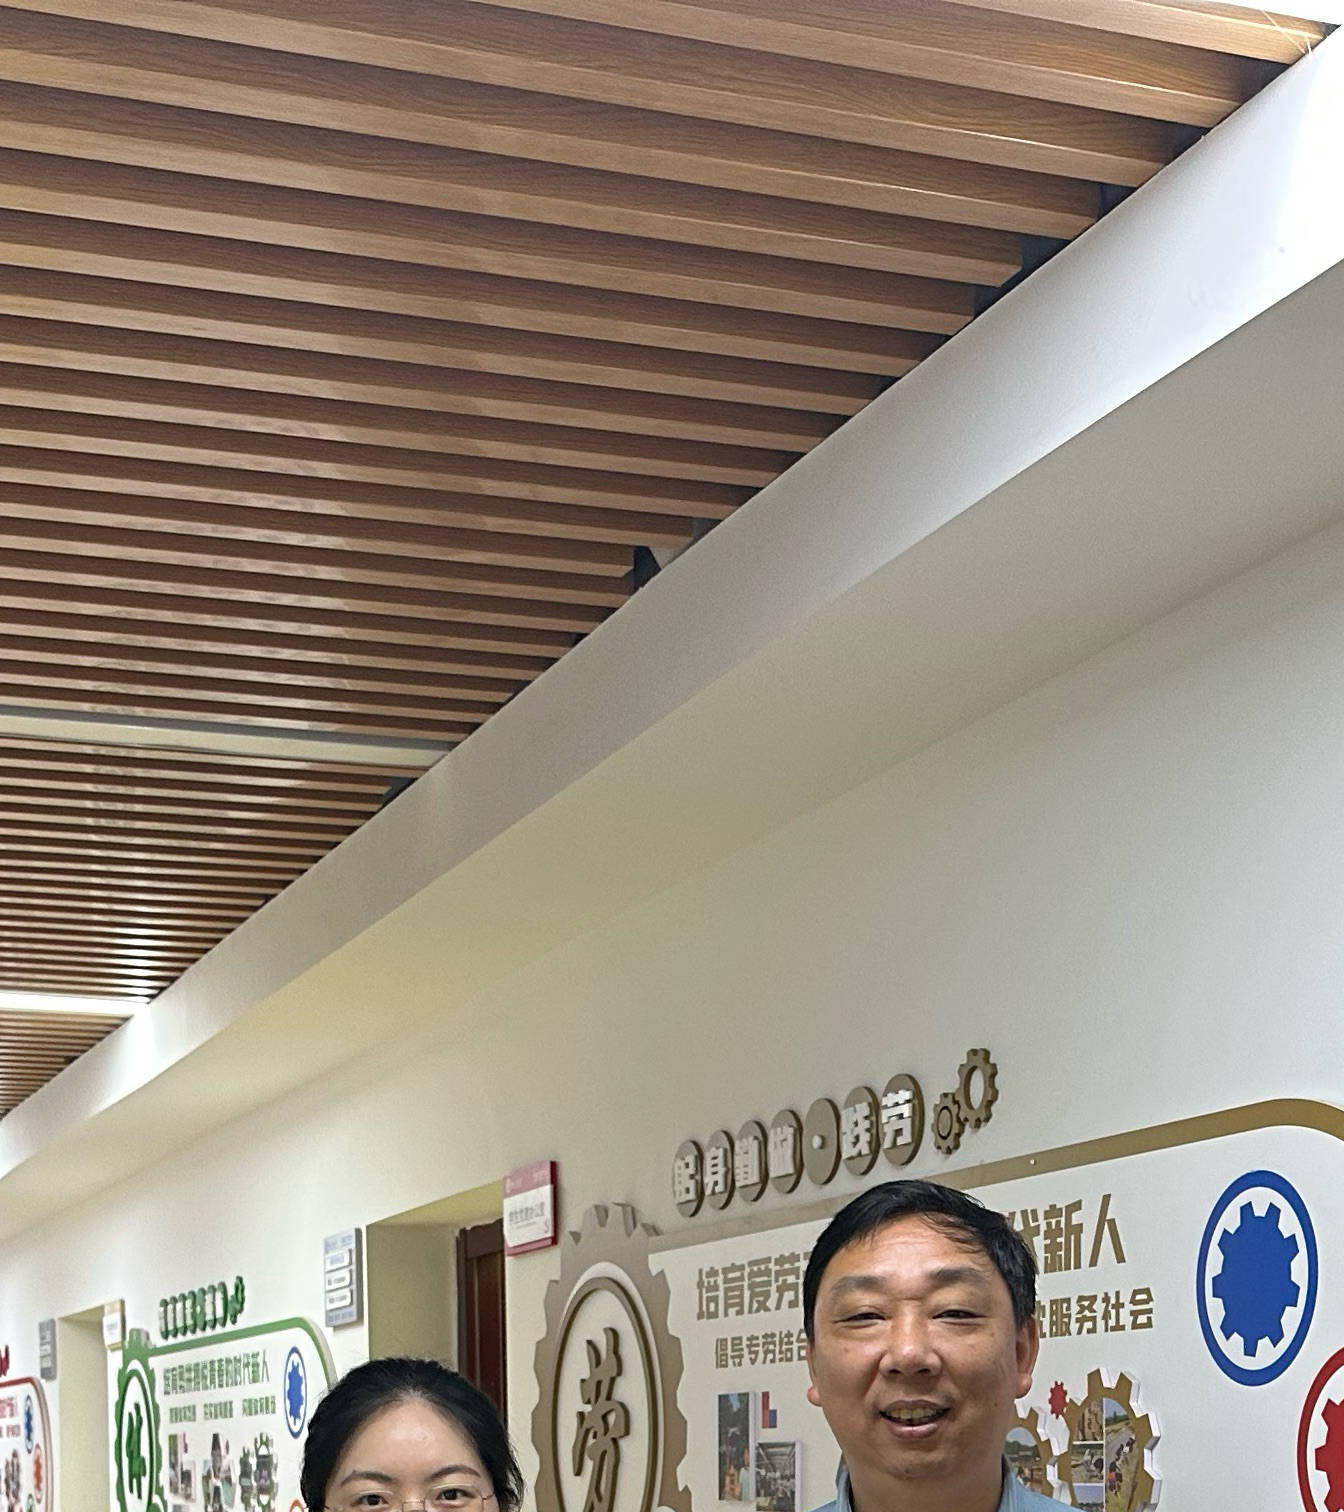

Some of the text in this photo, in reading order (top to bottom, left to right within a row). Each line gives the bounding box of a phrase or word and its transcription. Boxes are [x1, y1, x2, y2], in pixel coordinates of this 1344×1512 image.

[697, 1251, 812, 1321] 培育爱劳
[715, 1328, 808, 1369] 倡导专劳结合
